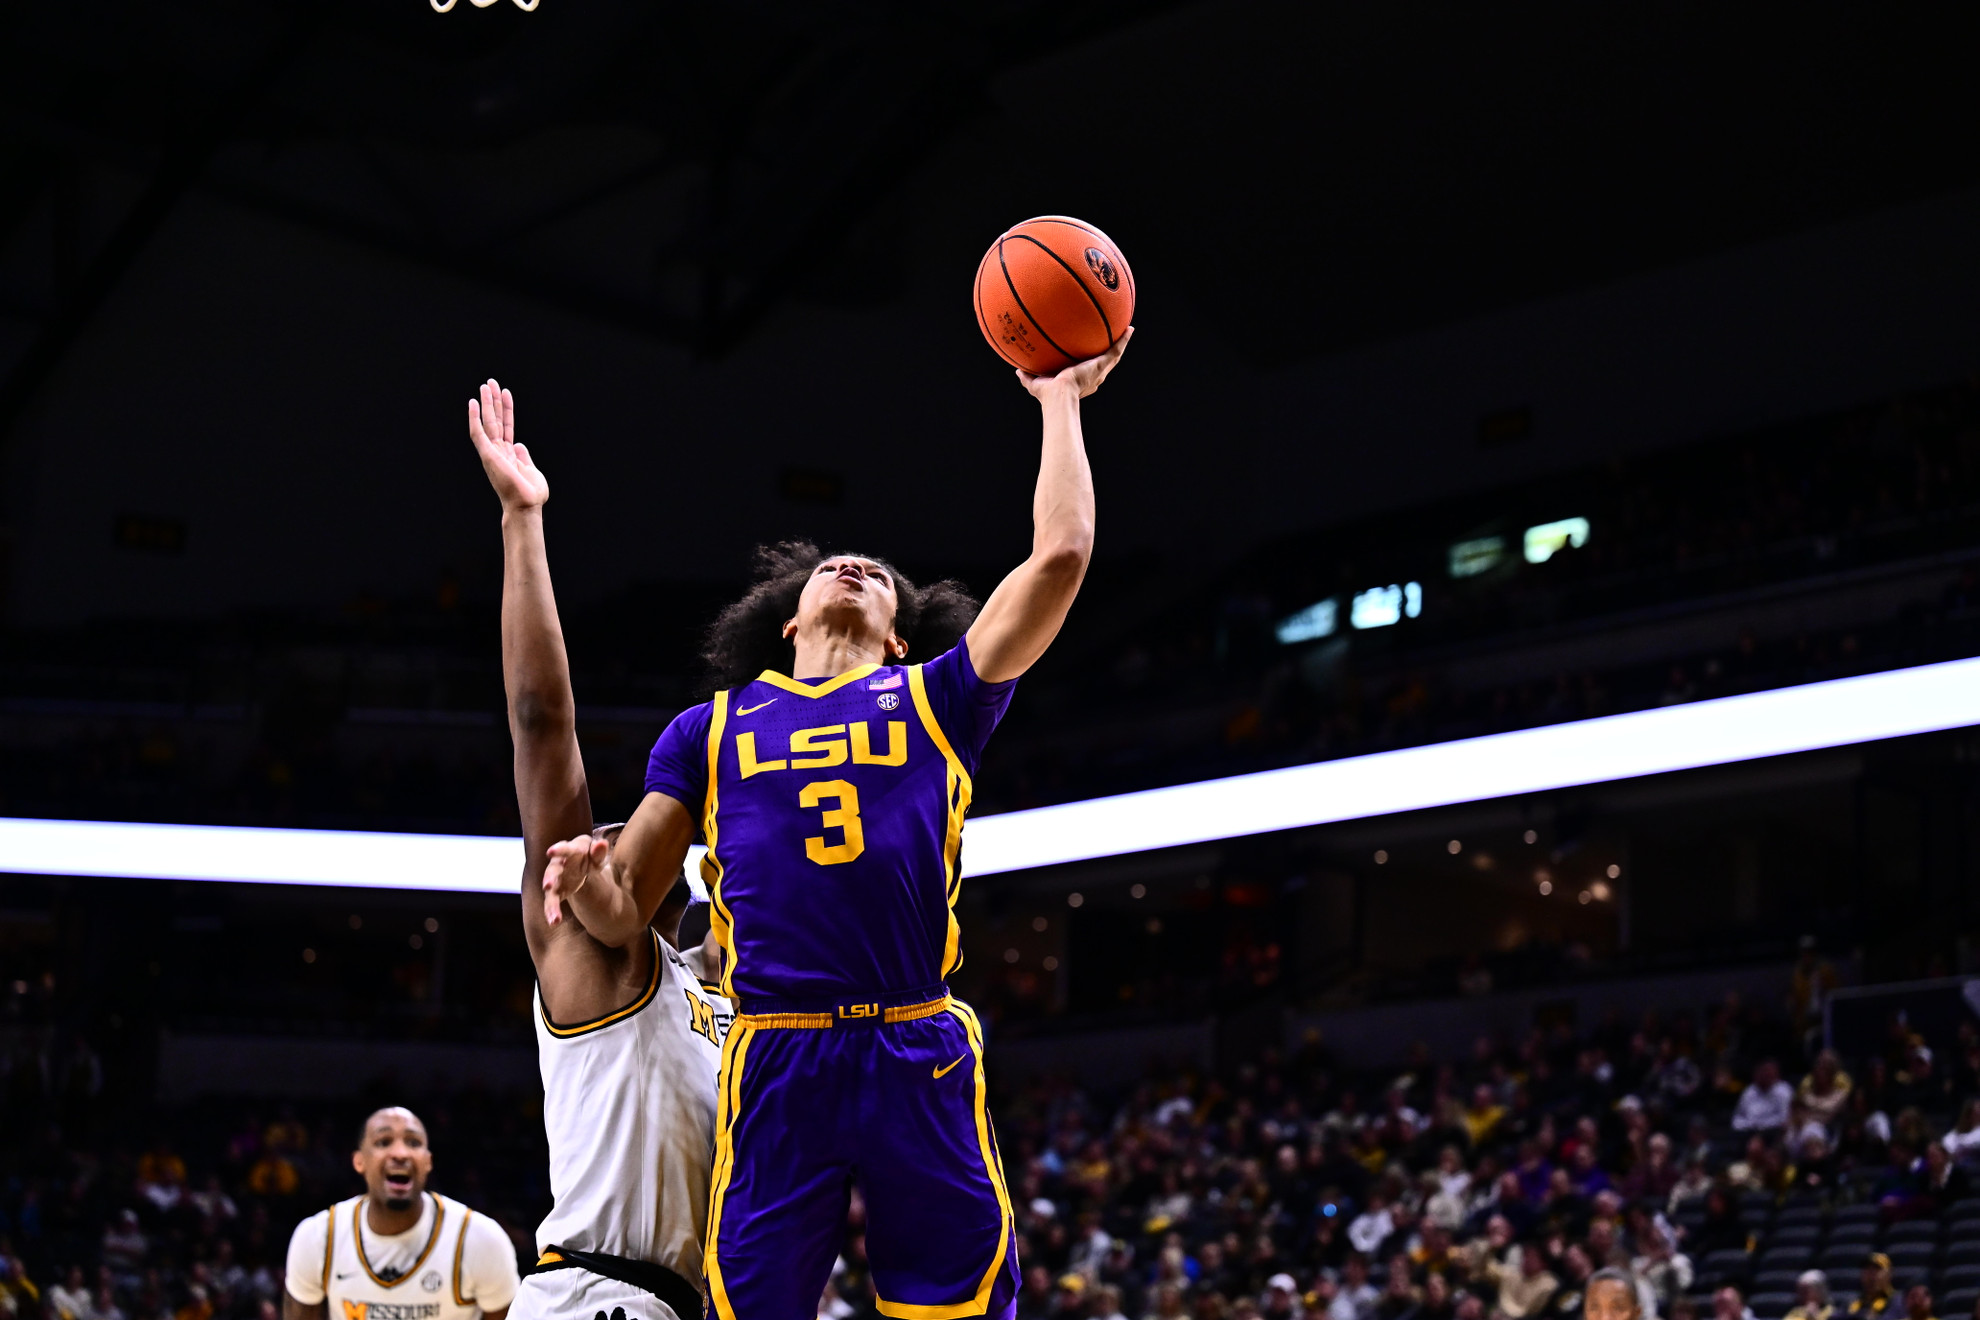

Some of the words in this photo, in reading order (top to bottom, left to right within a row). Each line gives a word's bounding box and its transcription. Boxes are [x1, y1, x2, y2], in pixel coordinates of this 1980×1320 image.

[879, 694, 898, 709] SEC
[736, 720, 908, 780] LSU
[799, 779, 865, 866] 3
[838, 1003, 879, 1019] LSU
